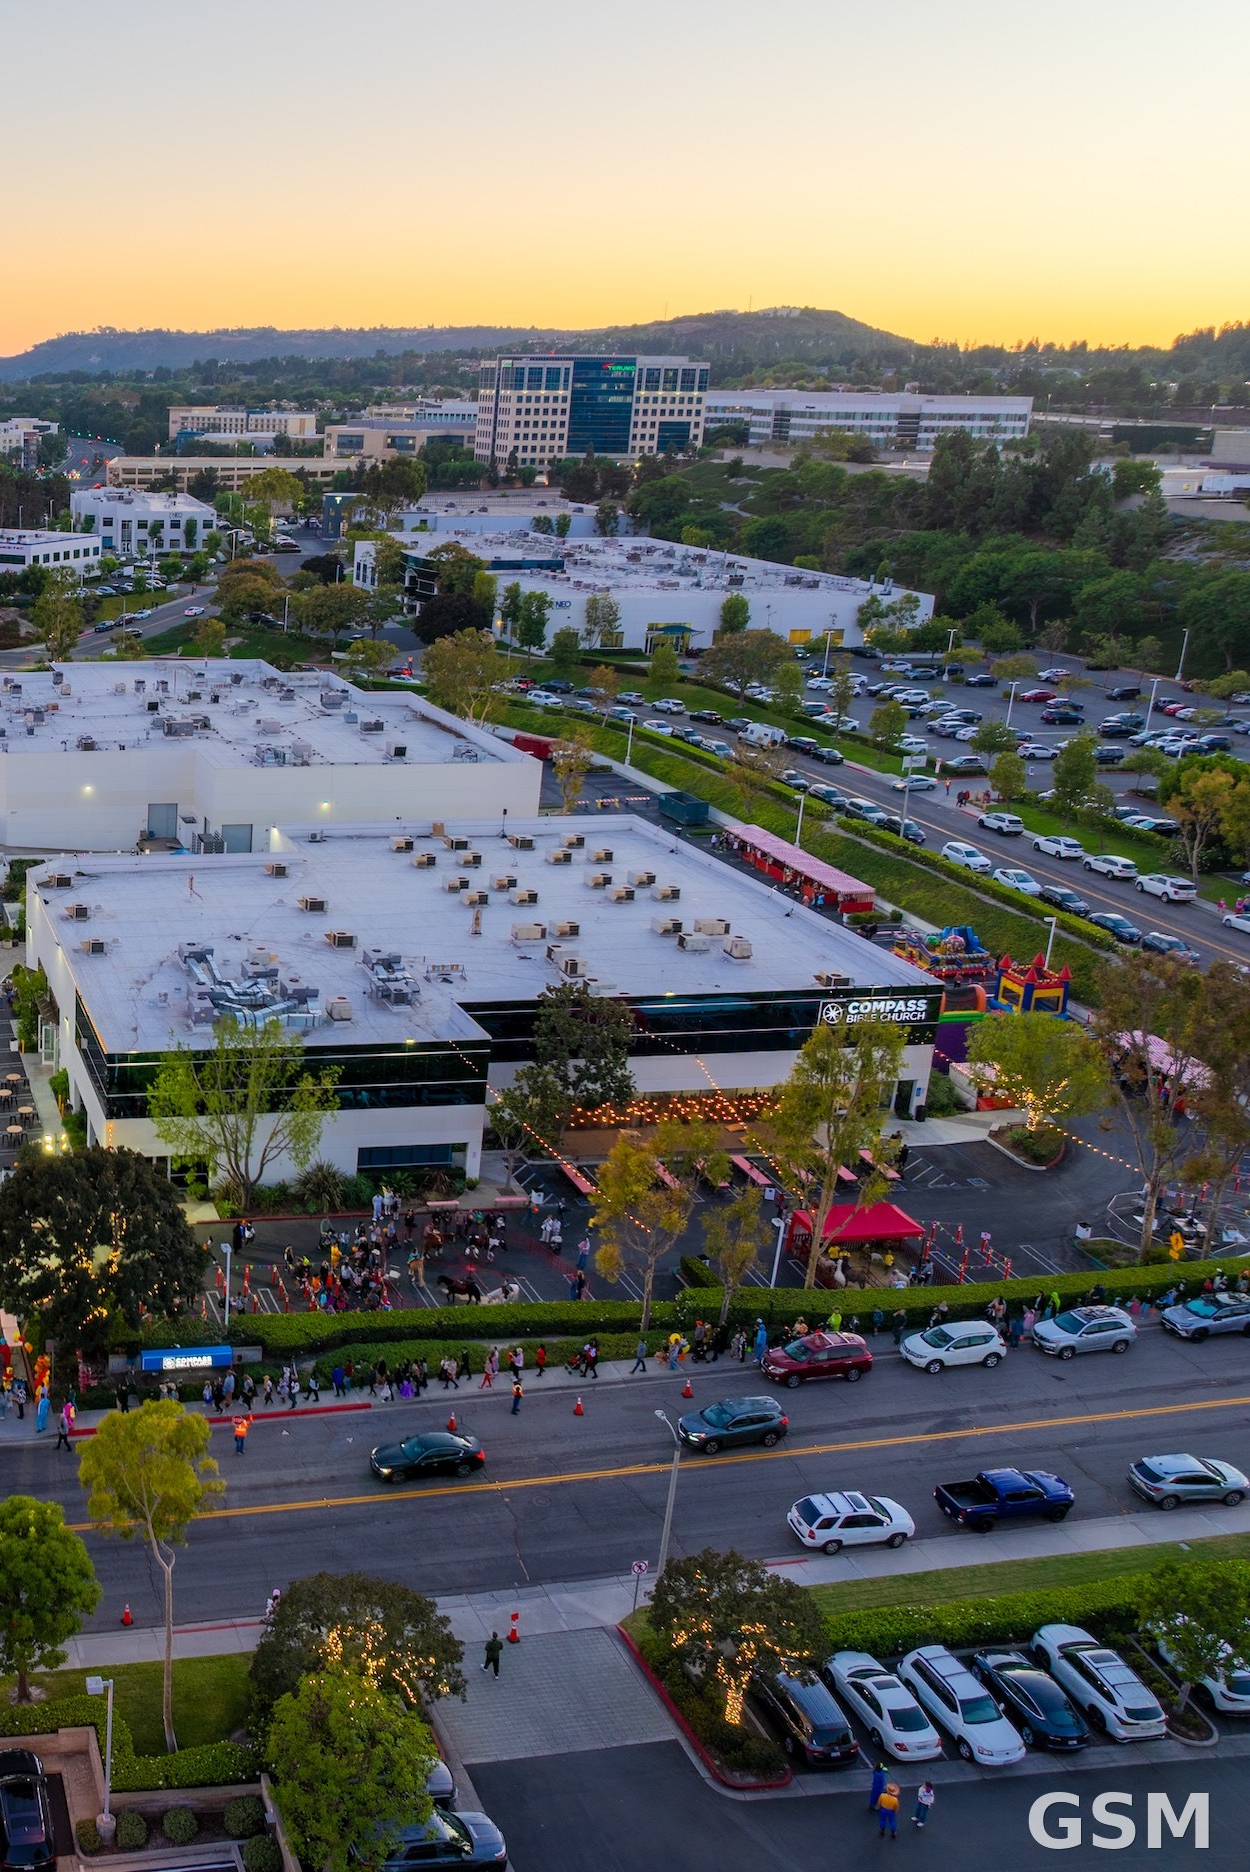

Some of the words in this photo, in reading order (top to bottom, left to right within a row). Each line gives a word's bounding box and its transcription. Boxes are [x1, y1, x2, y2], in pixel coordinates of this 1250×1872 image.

[848, 1000, 927, 1013] COMPASS
[880, 1012, 925, 1021] CHURCH
[175, 1356, 212, 1365] COMPASS
